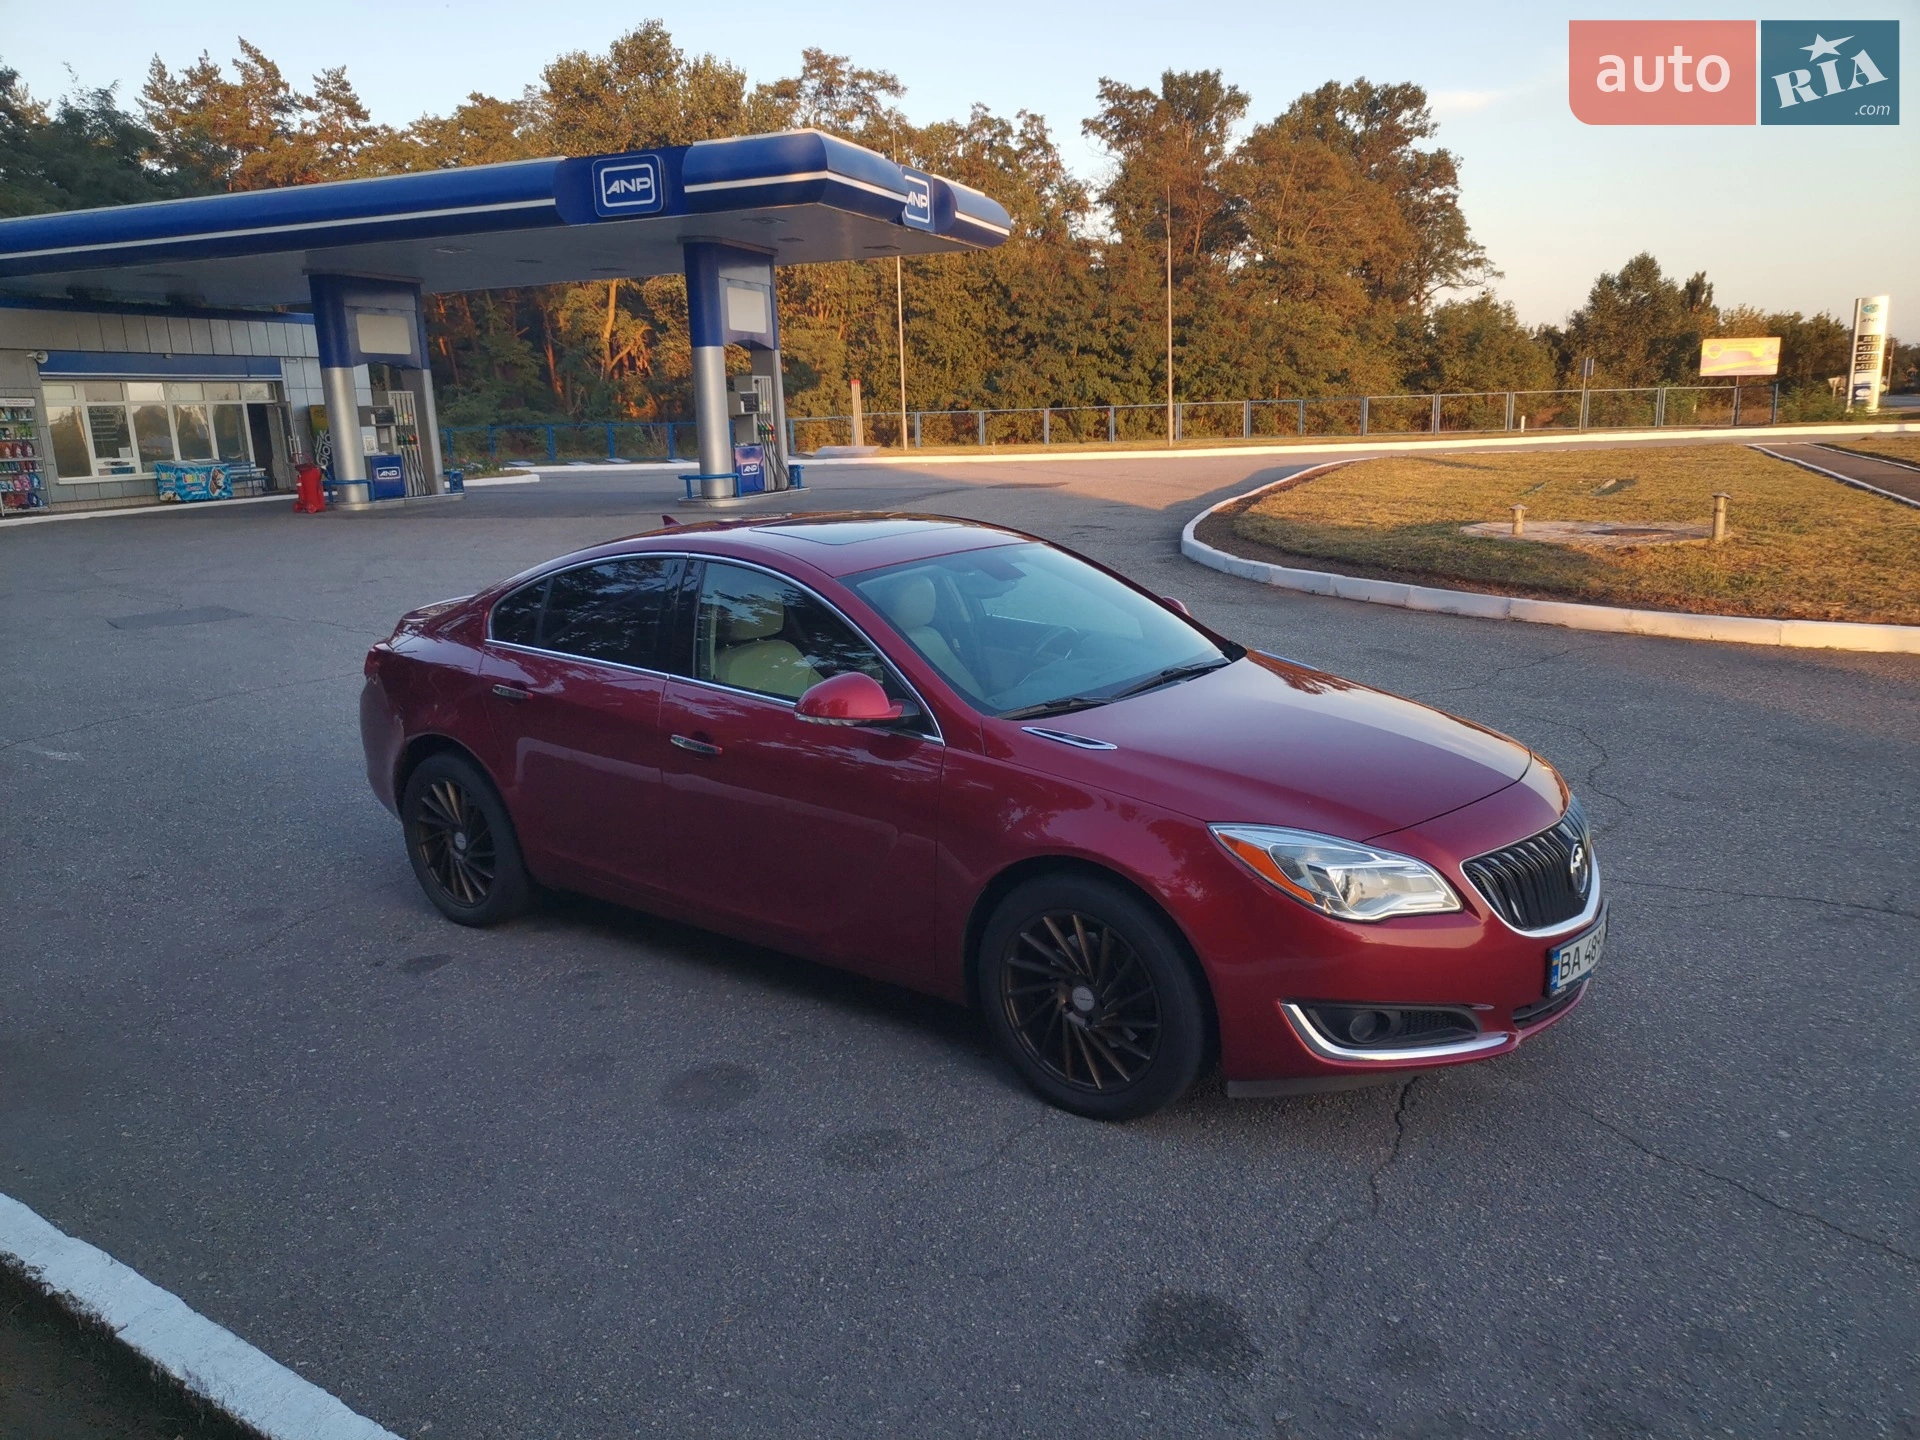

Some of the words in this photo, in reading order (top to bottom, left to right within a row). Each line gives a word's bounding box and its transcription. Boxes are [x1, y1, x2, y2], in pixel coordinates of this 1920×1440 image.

[606, 177, 652, 194] ANP
[906, 190, 929, 209] ANP
[1561, 946, 1581, 980] BA
